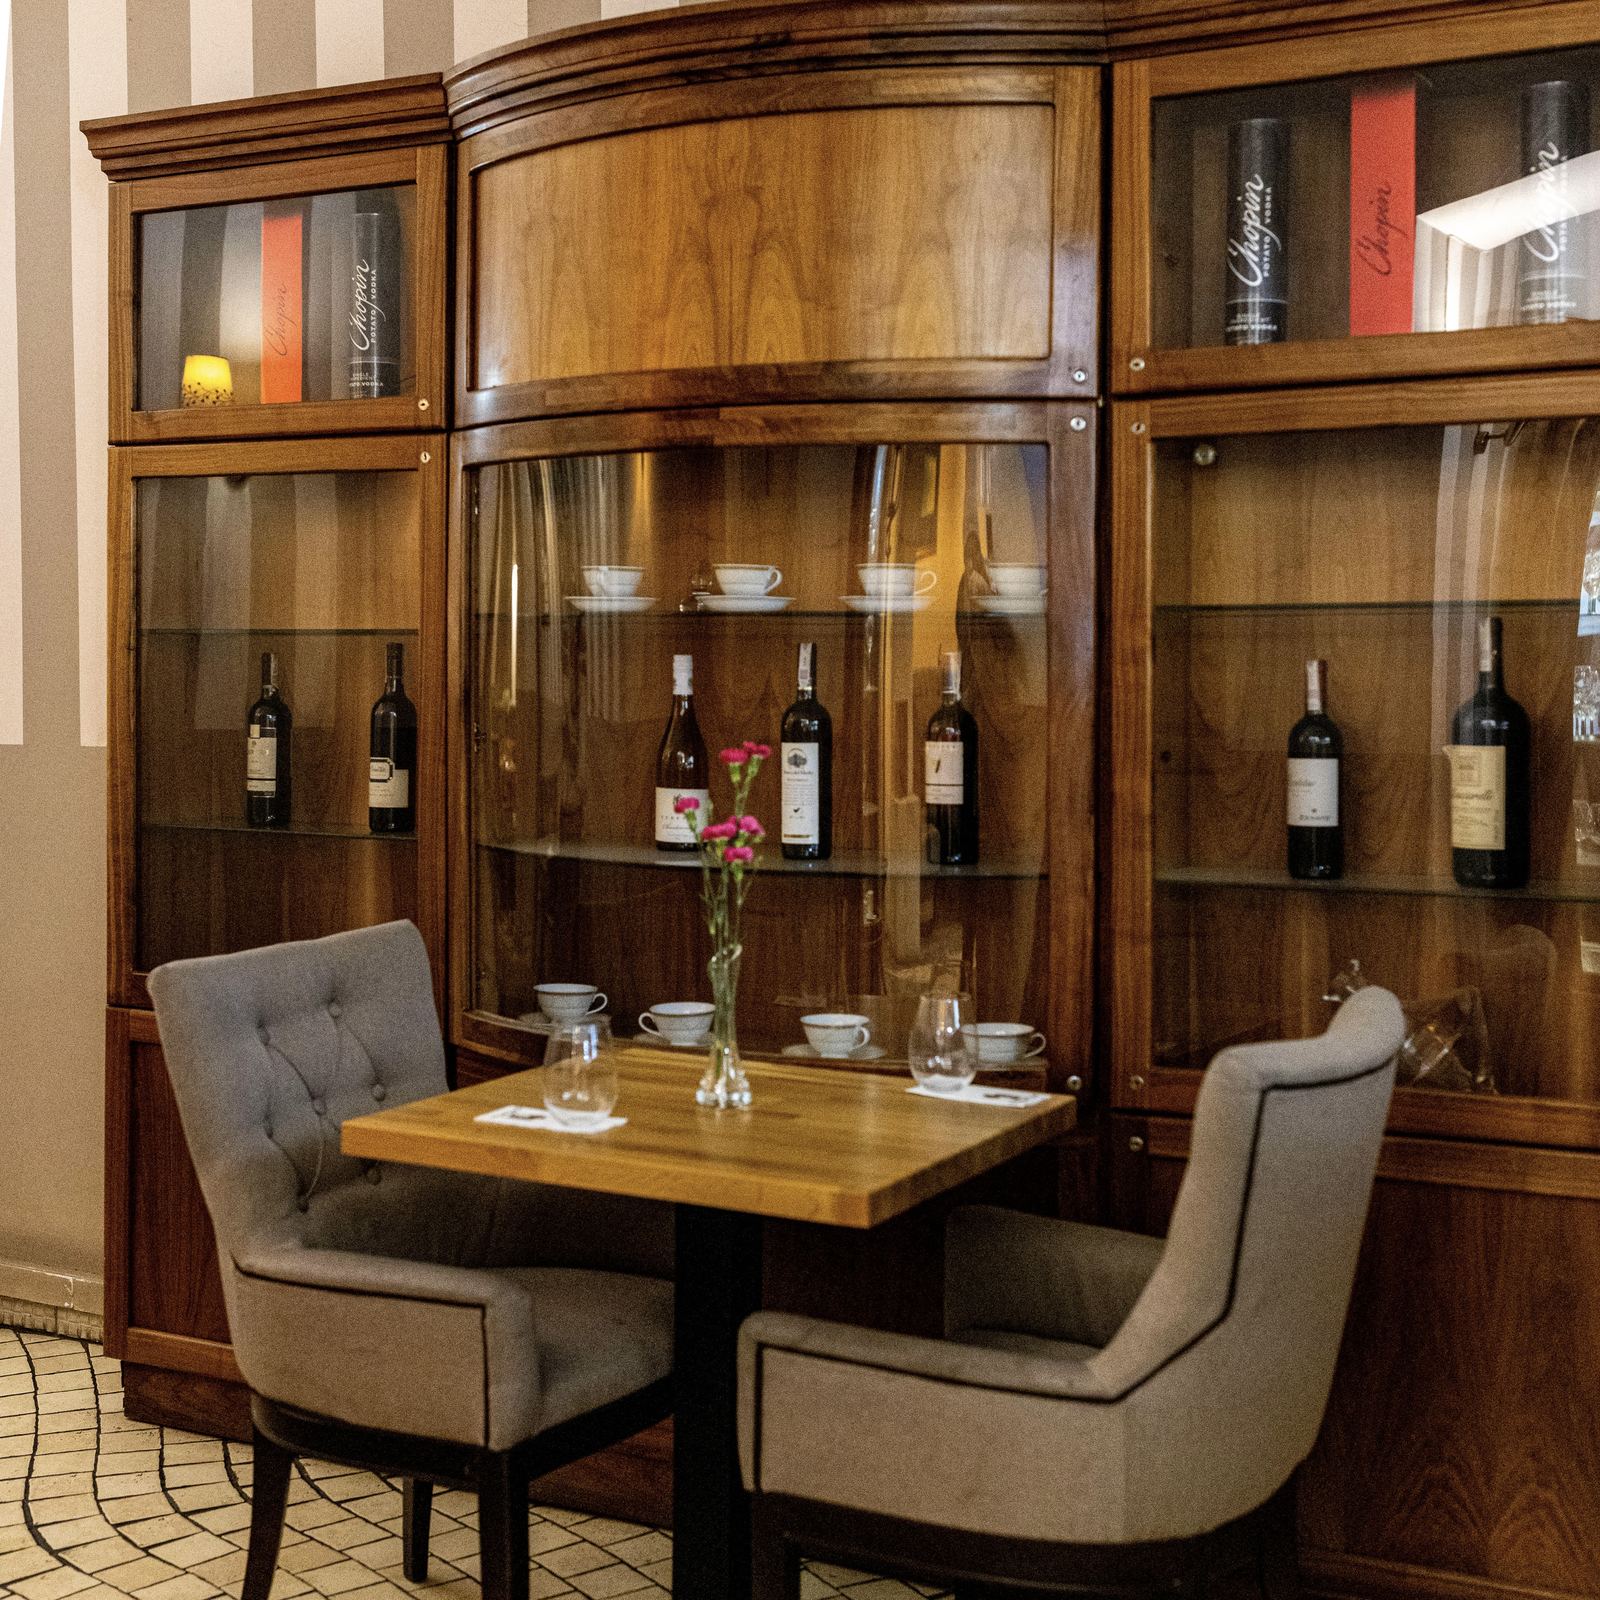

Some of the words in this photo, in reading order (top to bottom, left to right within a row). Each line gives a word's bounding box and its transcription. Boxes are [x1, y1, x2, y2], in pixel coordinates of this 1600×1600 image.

[1226, 173, 1282, 287] Chopin
[1264, 186, 1272, 224] VODKA
[1356, 182, 1408, 276] Chopin
[1522, 141, 1578, 262] Cpin
[1262, 235, 1271, 278] POTATO
[264, 281, 297, 356] Chopin
[348, 259, 387, 351] Chopin
